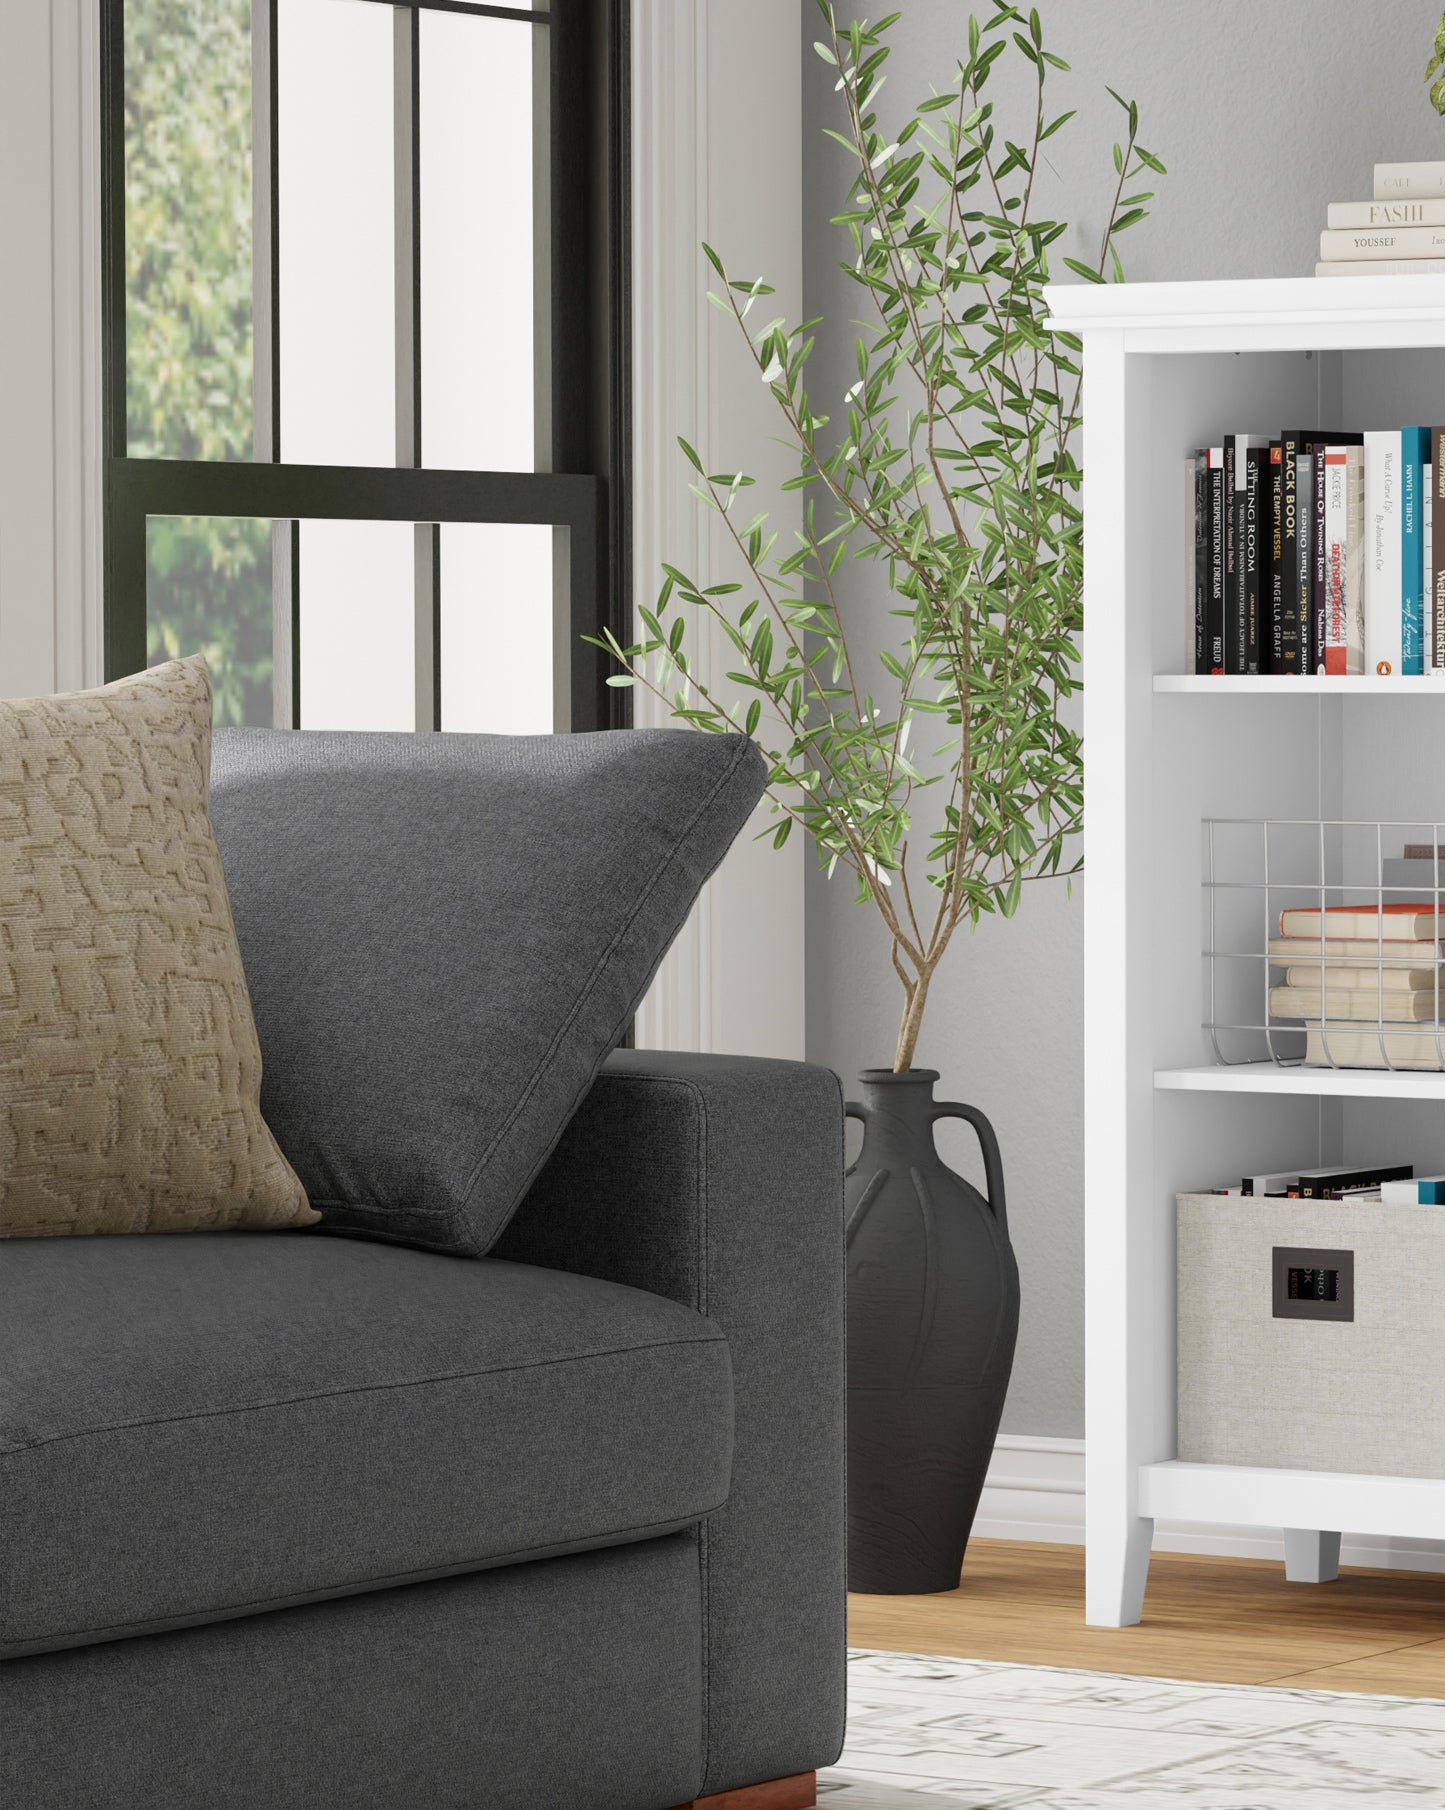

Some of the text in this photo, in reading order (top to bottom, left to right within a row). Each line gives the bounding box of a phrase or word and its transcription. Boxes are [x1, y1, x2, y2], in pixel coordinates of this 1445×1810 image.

[1354, 237, 1397, 248] YOUSSEF
[1384, 452, 1392, 471] What
[1405, 464, 1413, 492] HAMM
[1247, 461, 1256, 522] SITTING
[1286, 441, 1296, 540] BLACK BOOK
[1317, 470, 1325, 500] HOUSE
[1299, 508, 1307, 548] Others
[1405, 504, 1413, 534] RACHEL
[1247, 524, 1256, 573] ROOM
[1299, 551, 1308, 582] Than
[1331, 543, 1341, 575] DEATH
[1213, 472, 1222, 662] THE INTERPRETATION OF DREAMS FREUD
[1273, 475, 1281, 659] THE EMPTY VESSEL ANGELLA GRAFF
[1299, 584, 1308, 622] Sicker
[1331, 607, 1341, 643] FOREST
